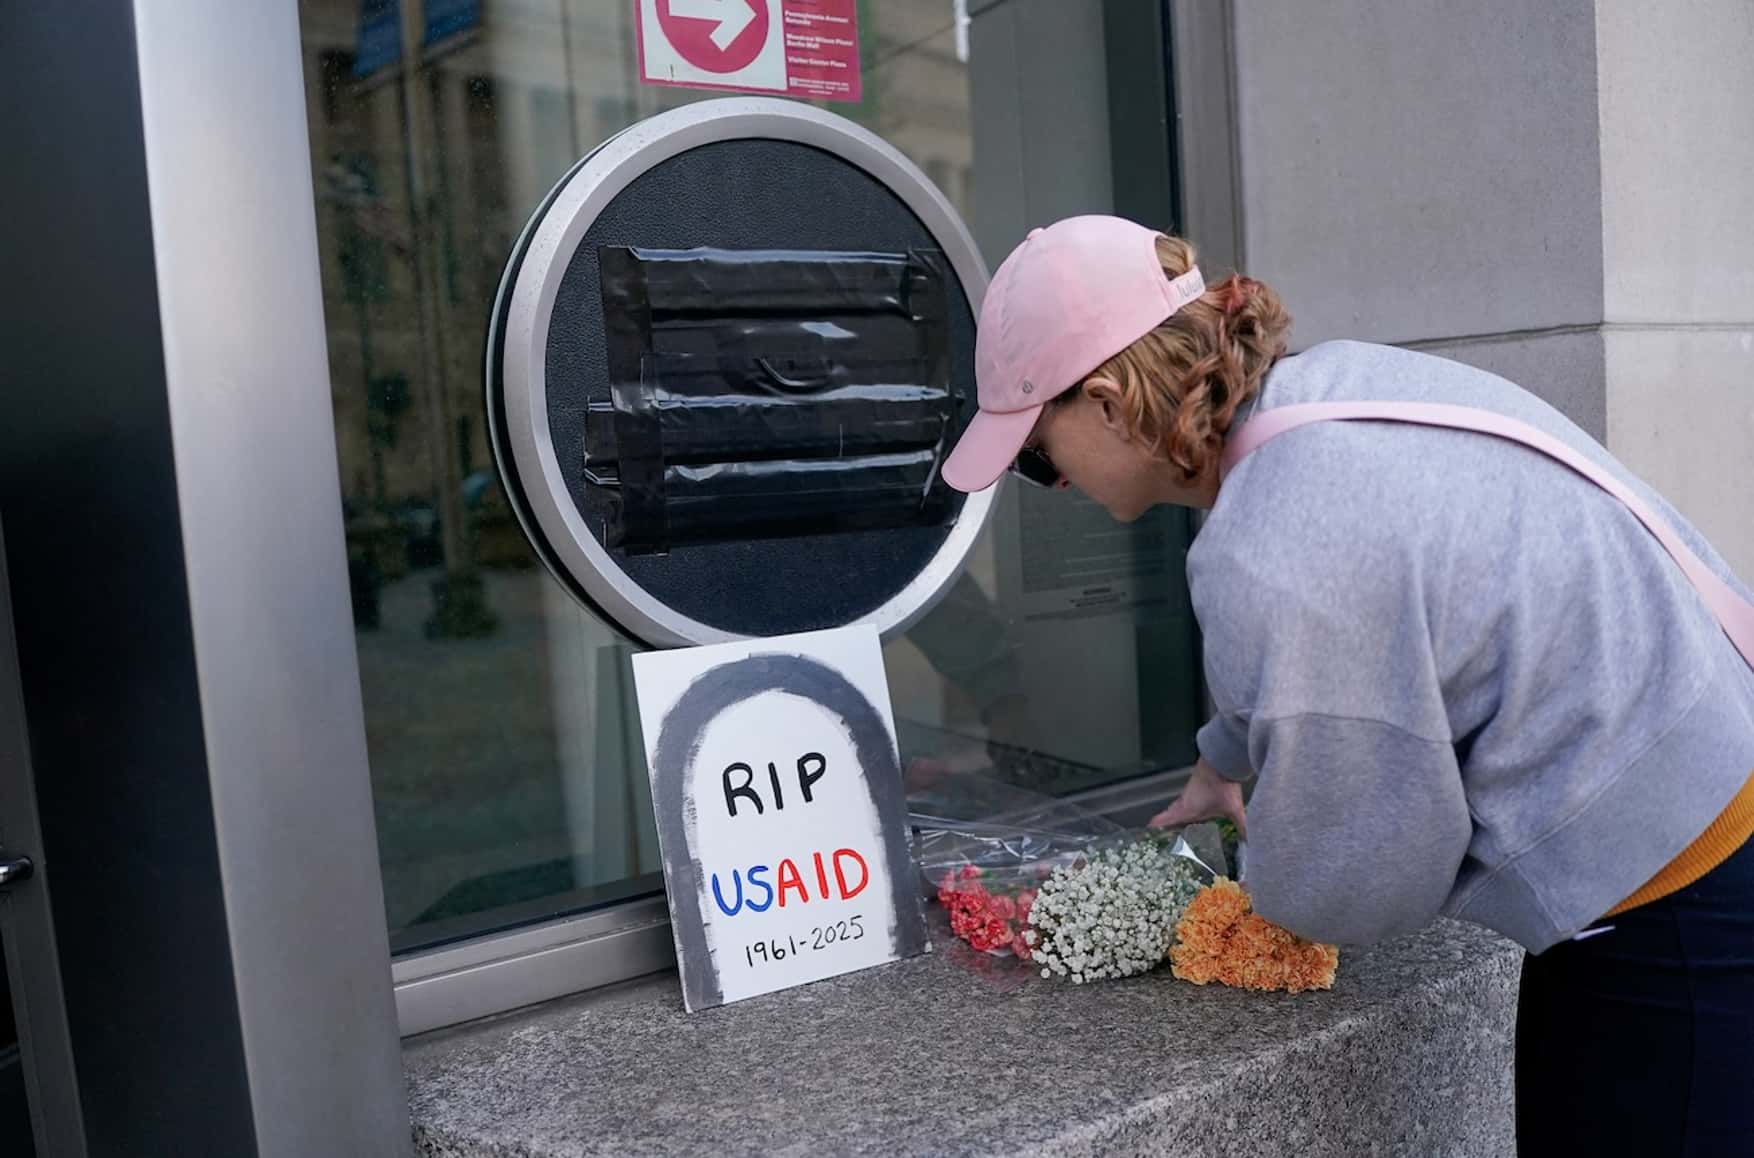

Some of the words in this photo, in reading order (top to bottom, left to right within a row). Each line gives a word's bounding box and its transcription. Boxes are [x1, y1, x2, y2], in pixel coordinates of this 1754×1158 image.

[815, 36, 835, 44] Wilson
[722, 752, 826, 817] RIP
[712, 848, 869, 916] USAID
[745, 914, 865, 967] 1961-2025
